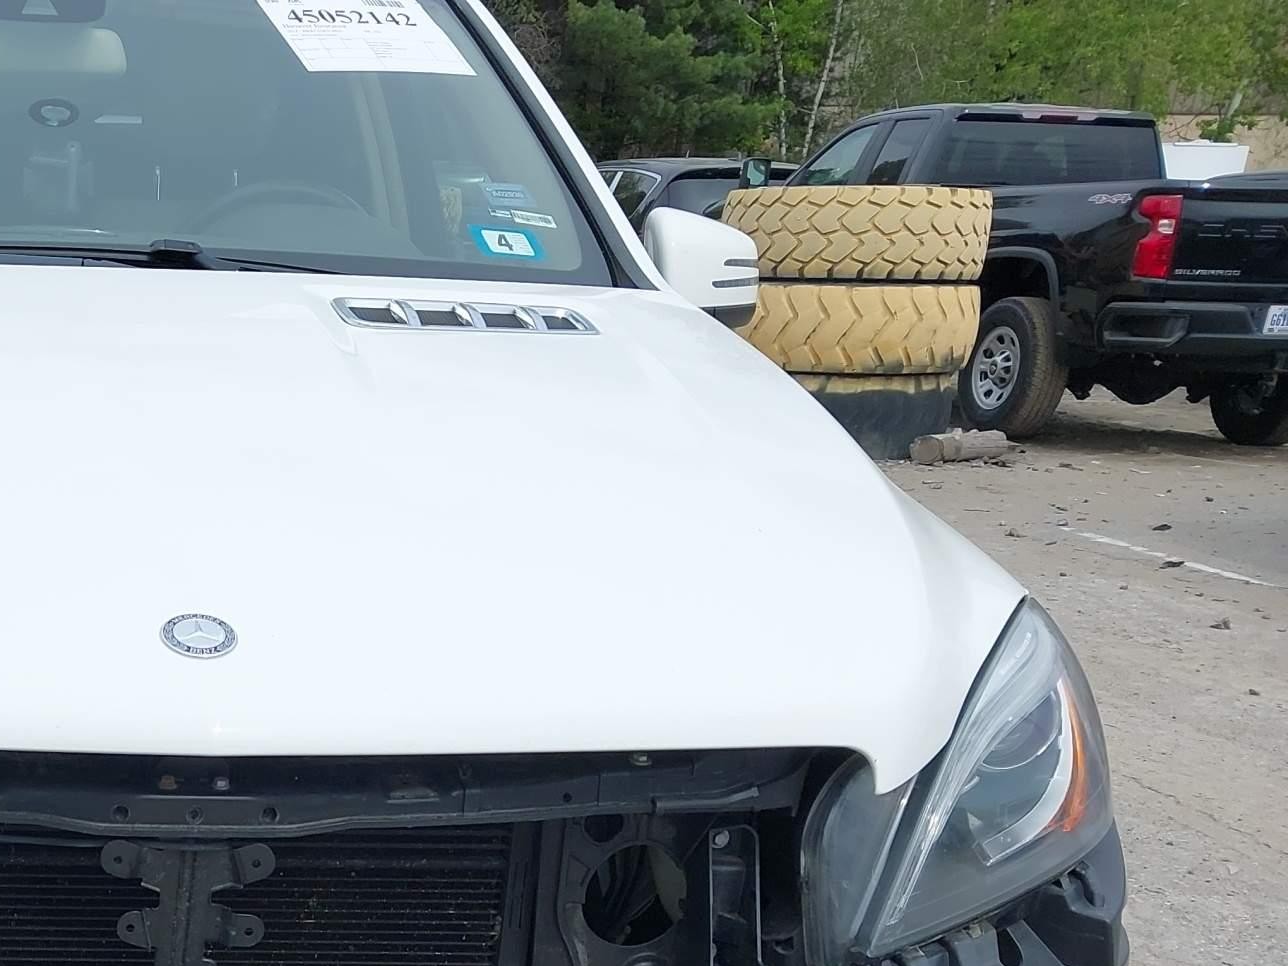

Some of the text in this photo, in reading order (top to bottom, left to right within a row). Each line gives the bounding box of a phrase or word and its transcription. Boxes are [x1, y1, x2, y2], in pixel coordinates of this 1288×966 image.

[286, 8, 418, 27] 45052142
[497, 233, 514, 252] 4
[1269, 313, 1288, 327] G61
